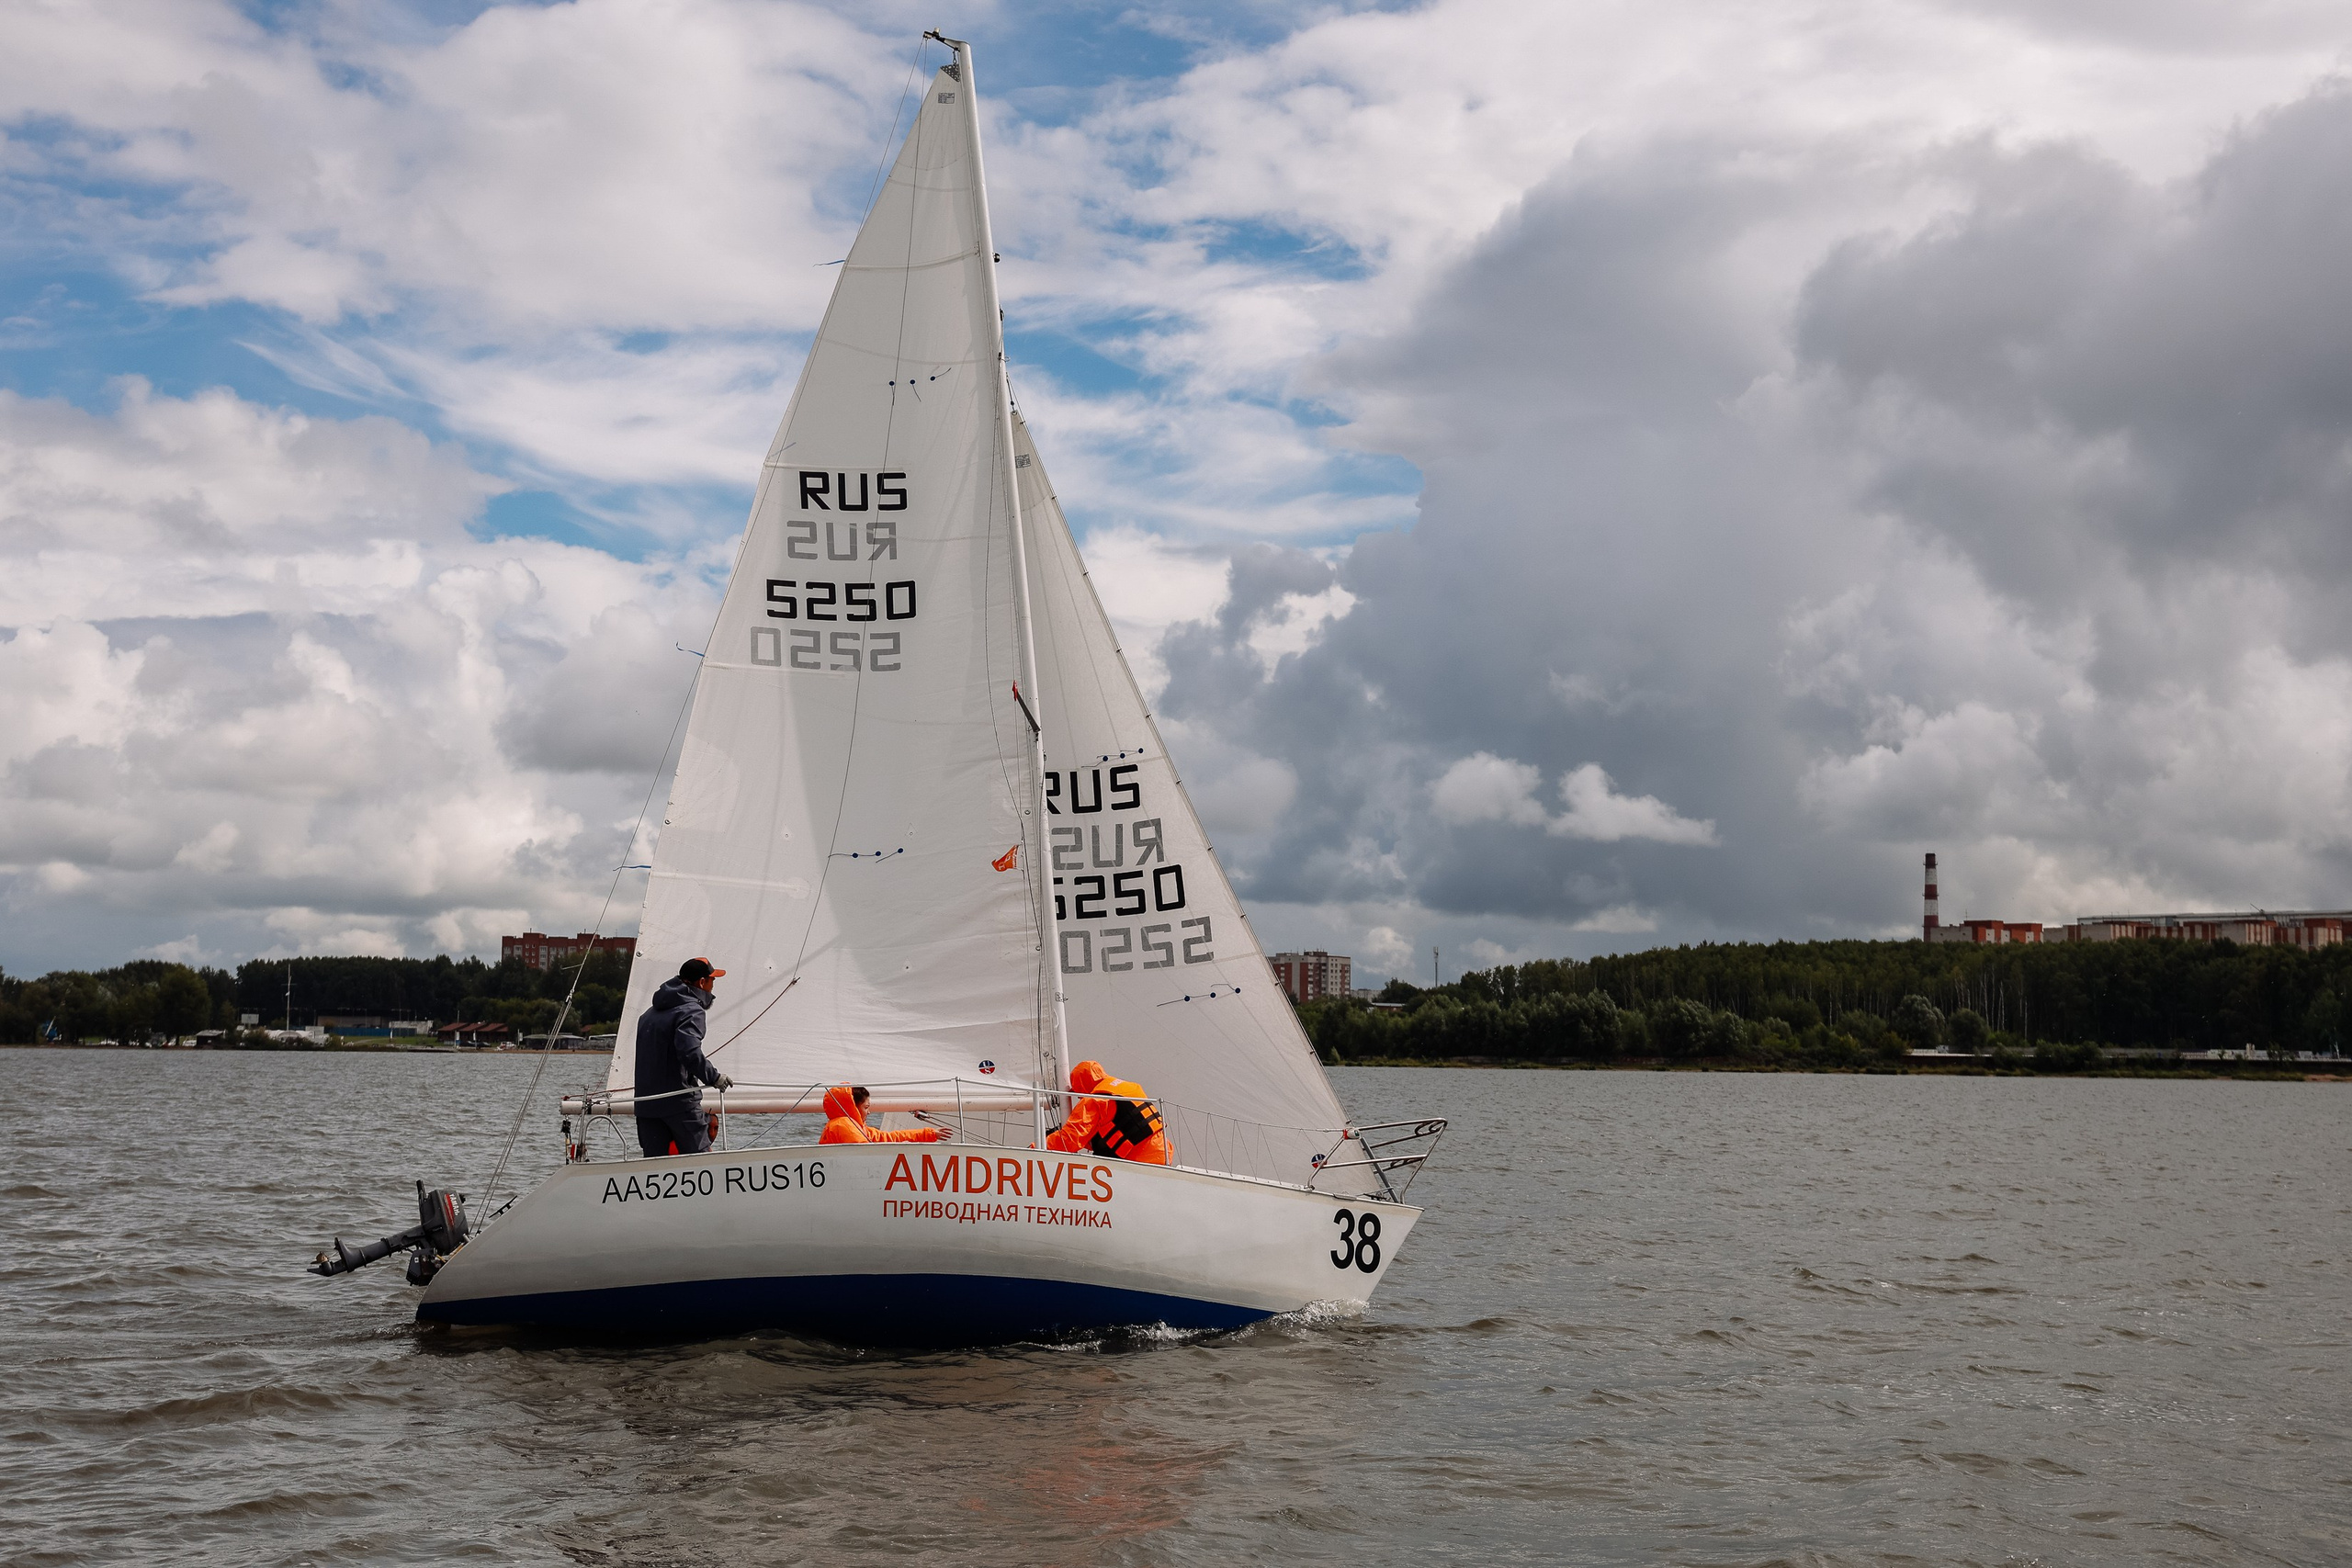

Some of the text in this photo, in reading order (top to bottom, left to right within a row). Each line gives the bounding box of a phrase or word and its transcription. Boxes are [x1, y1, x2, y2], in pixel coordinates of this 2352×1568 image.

[799, 471, 908, 511] RUS
[766, 579, 916, 621] 5250
[602, 1162, 826, 1203] AA5250 RUS16
[884, 1153, 1114, 1202] AMDRIVES
[883, 1200, 1113, 1228] ПРИВОДНАЯ ТЕХНИКА
[1330, 1208, 1381, 1273] 38
